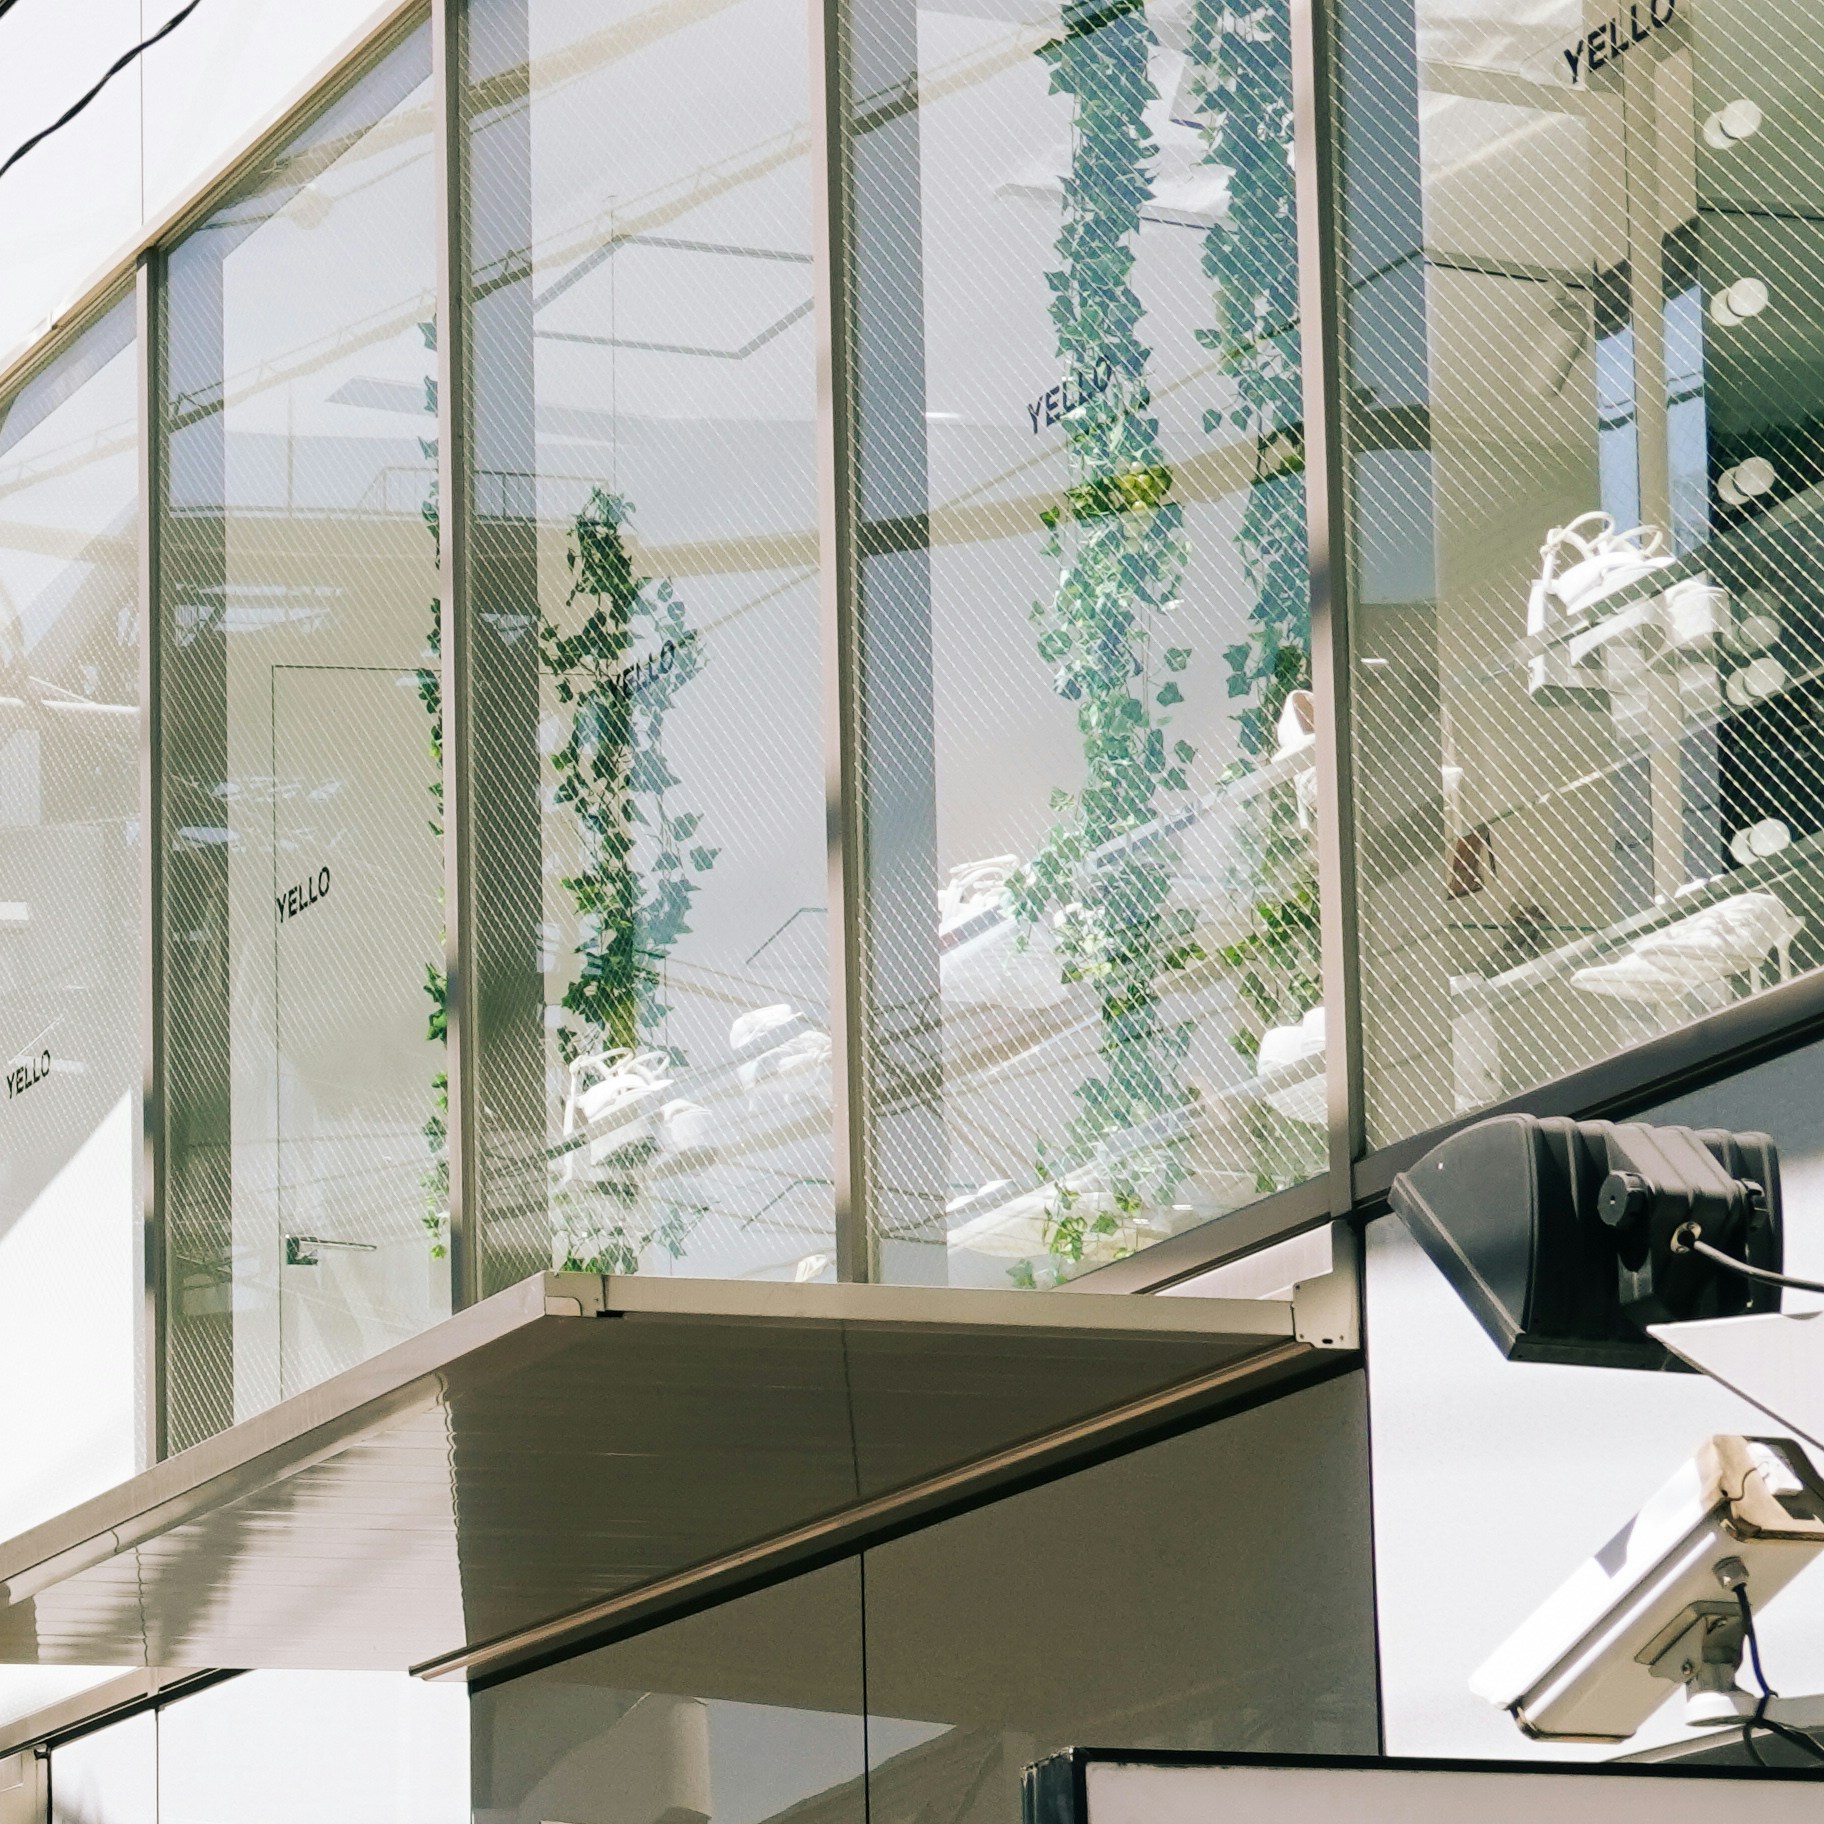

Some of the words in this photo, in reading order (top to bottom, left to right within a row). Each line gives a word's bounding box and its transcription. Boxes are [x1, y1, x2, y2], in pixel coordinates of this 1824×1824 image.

[1563, 0, 1676, 84] YELLO
[276, 866, 330, 923] YELLO
[7, 1049, 50, 1099] YELLO
